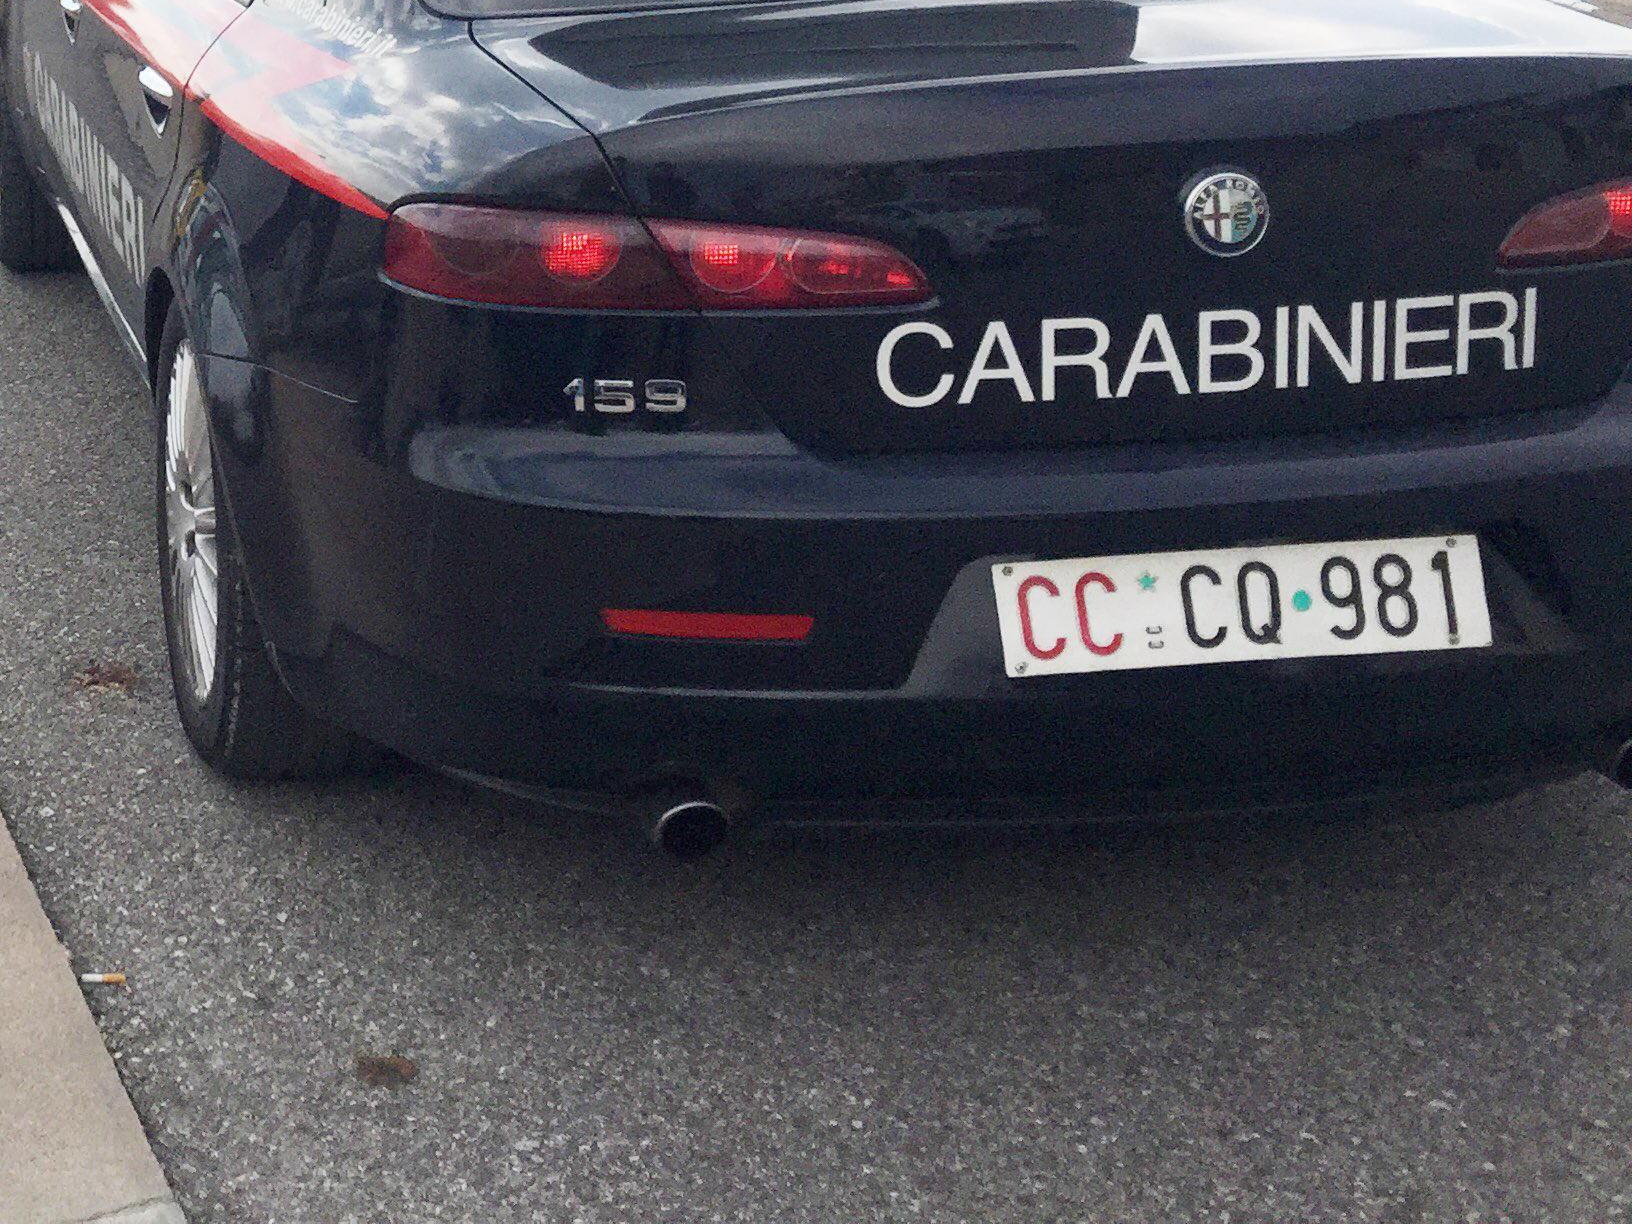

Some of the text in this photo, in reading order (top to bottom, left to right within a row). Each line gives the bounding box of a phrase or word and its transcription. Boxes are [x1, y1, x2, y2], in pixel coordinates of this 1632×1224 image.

[562, 377, 687, 413] 159
[875, 287, 1538, 408] CARABINIERI
[1016, 550, 1460, 660] CC CQ 981
